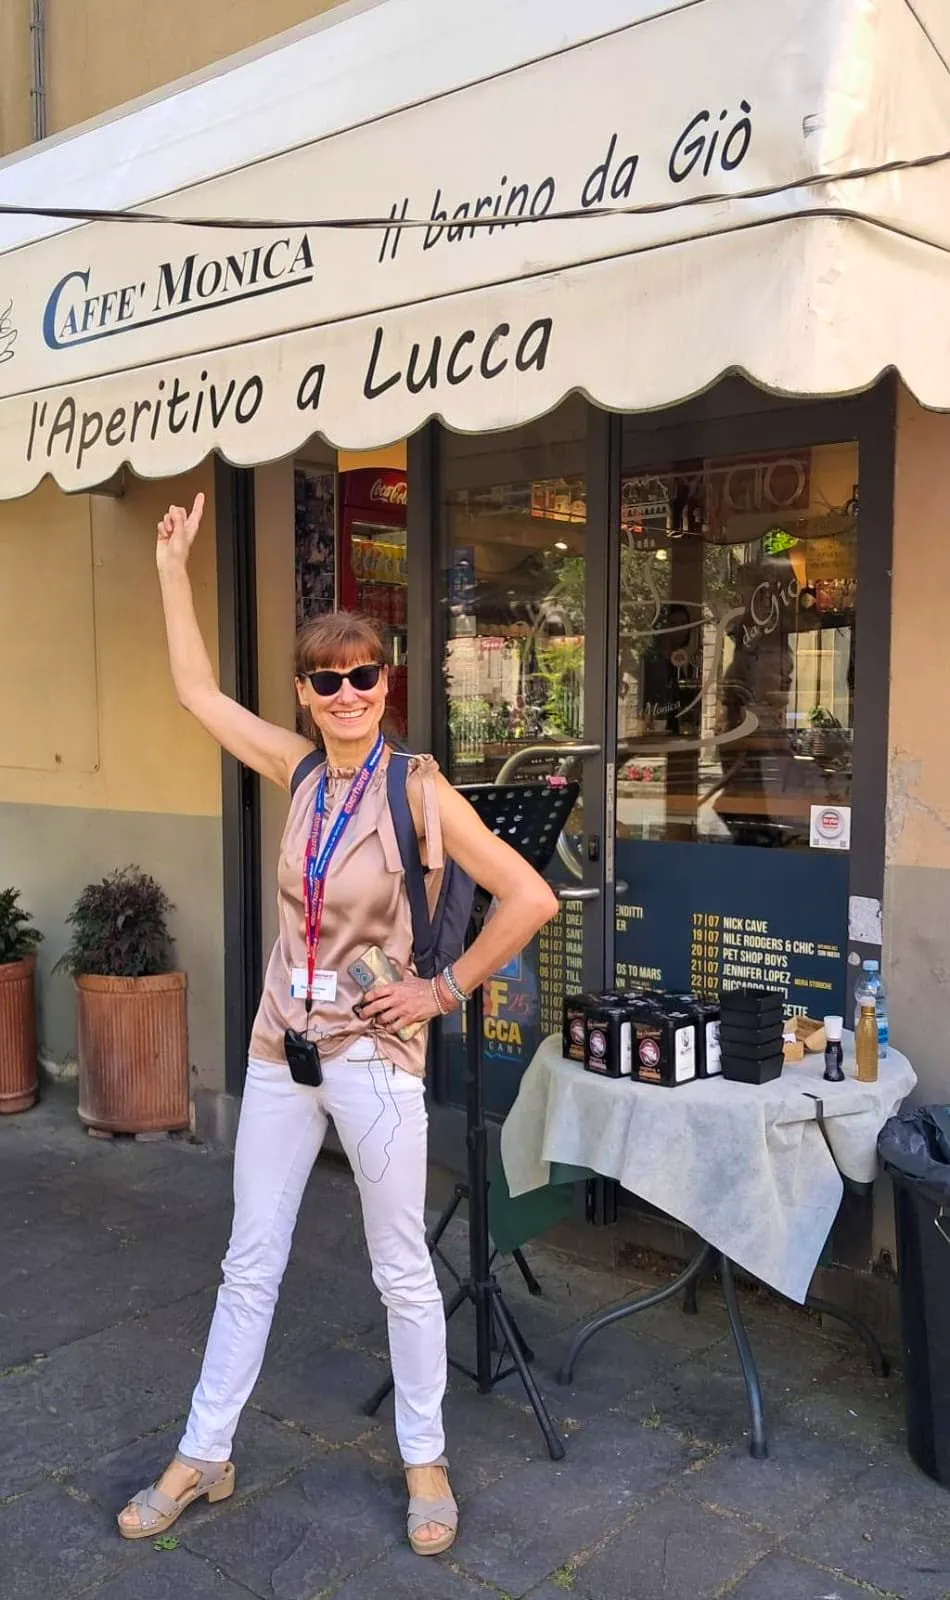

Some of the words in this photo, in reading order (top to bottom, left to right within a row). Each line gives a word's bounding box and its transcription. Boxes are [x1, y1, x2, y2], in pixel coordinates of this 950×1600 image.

[423, 174, 555, 251] barino
[581, 133, 639, 208] da
[668, 99, 752, 184] Giò
[42, 267, 145, 350] CAFFE'
[153, 233, 315, 312] MONICA
[26, 370, 263, 469] l'Aperitivo
[296, 363, 325, 411] a
[363, 317, 553, 400] Lucca
[616, 904, 643, 920] ENDITTI
[723, 916, 744, 931] NICK
[744, 919, 769, 934] CAVE
[723, 932, 744, 946] NILE
[743, 934, 784, 952] RODGERS
[785, 940, 792, 953] &
[793, 941, 815, 956] CHIC
[723, 947, 739, 961] PET
[740, 949, 763, 965] SHOP
[764, 952, 788, 968] BOYS
[628, 964, 639, 977] TO
[639, 966, 663, 981] MARS
[722, 963, 762, 981] JENNIFER
[763, 968, 791, 985] LOPEZ
[484, 1016, 523, 1045] CCA
[488, 1041, 523, 1055] CANY
